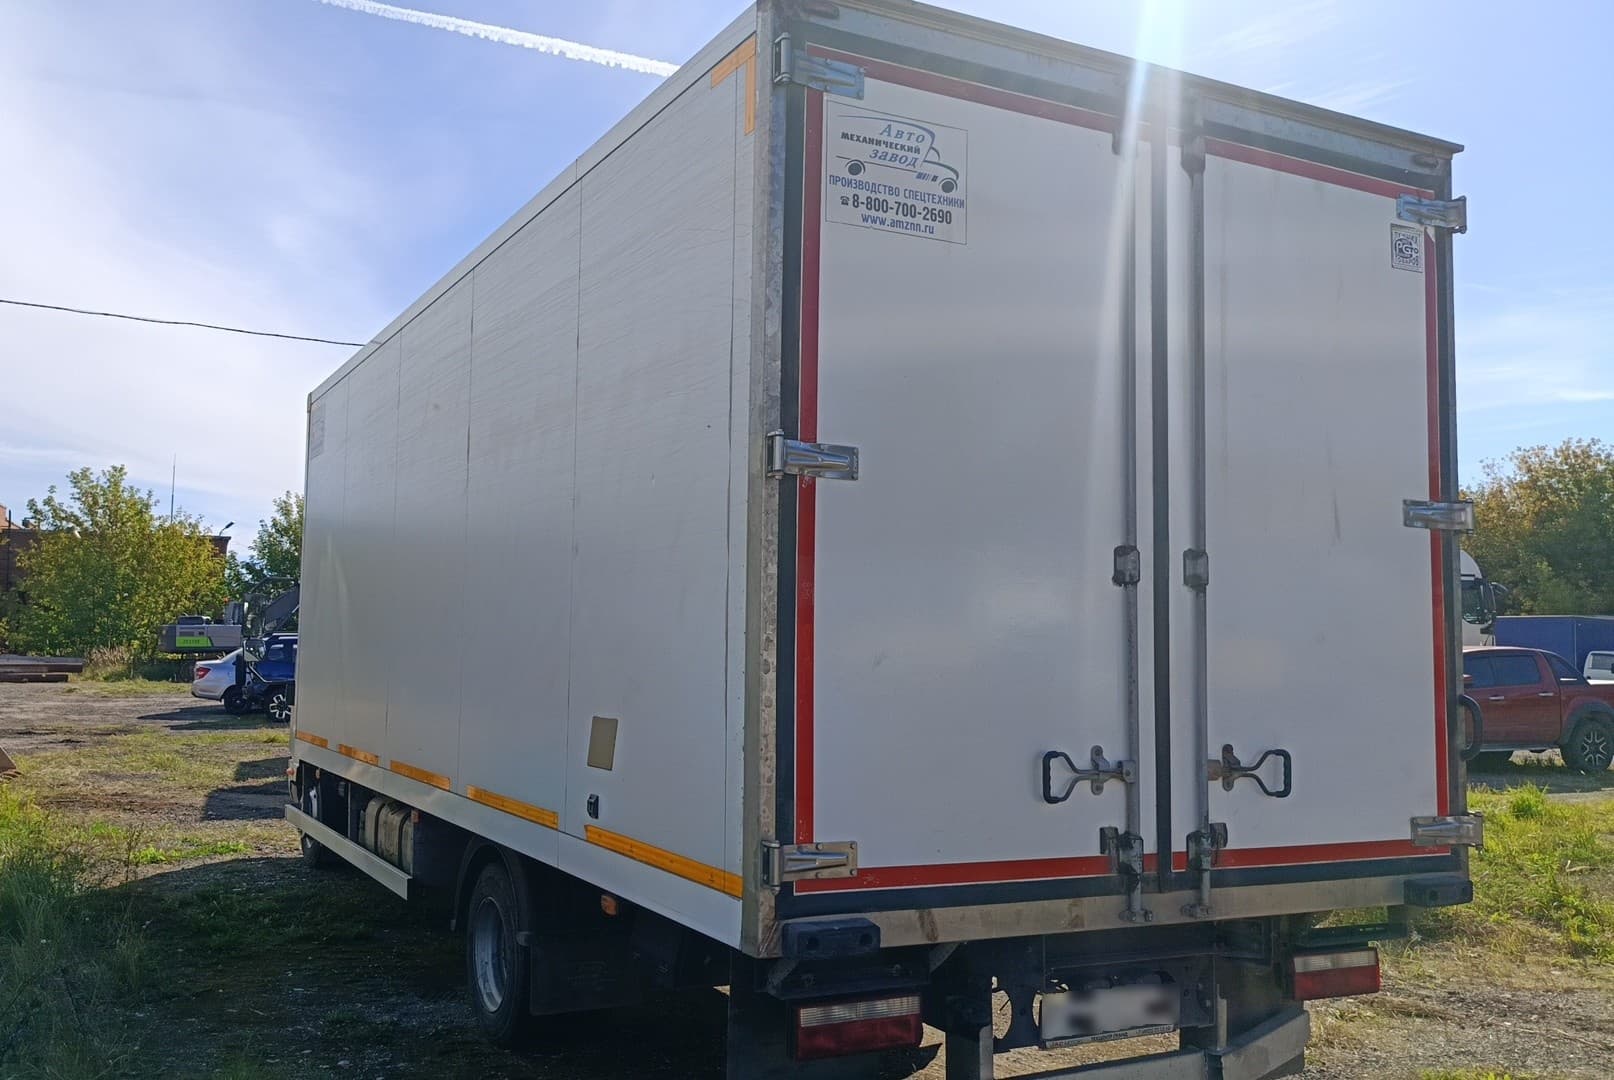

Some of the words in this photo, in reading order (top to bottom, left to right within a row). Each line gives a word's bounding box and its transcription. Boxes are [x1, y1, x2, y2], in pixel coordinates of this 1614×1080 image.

[840, 132, 921, 155] МЕХАНИЧЕСКИЙ
[829, 174, 900, 197] ПРОИЗВОДСТВО
[904, 188, 965, 209] СПЕЦТЕХНИКИ
[852, 194, 952, 225] 8-800-700-2690
[861, 213, 934, 235] www.amznn.ru
